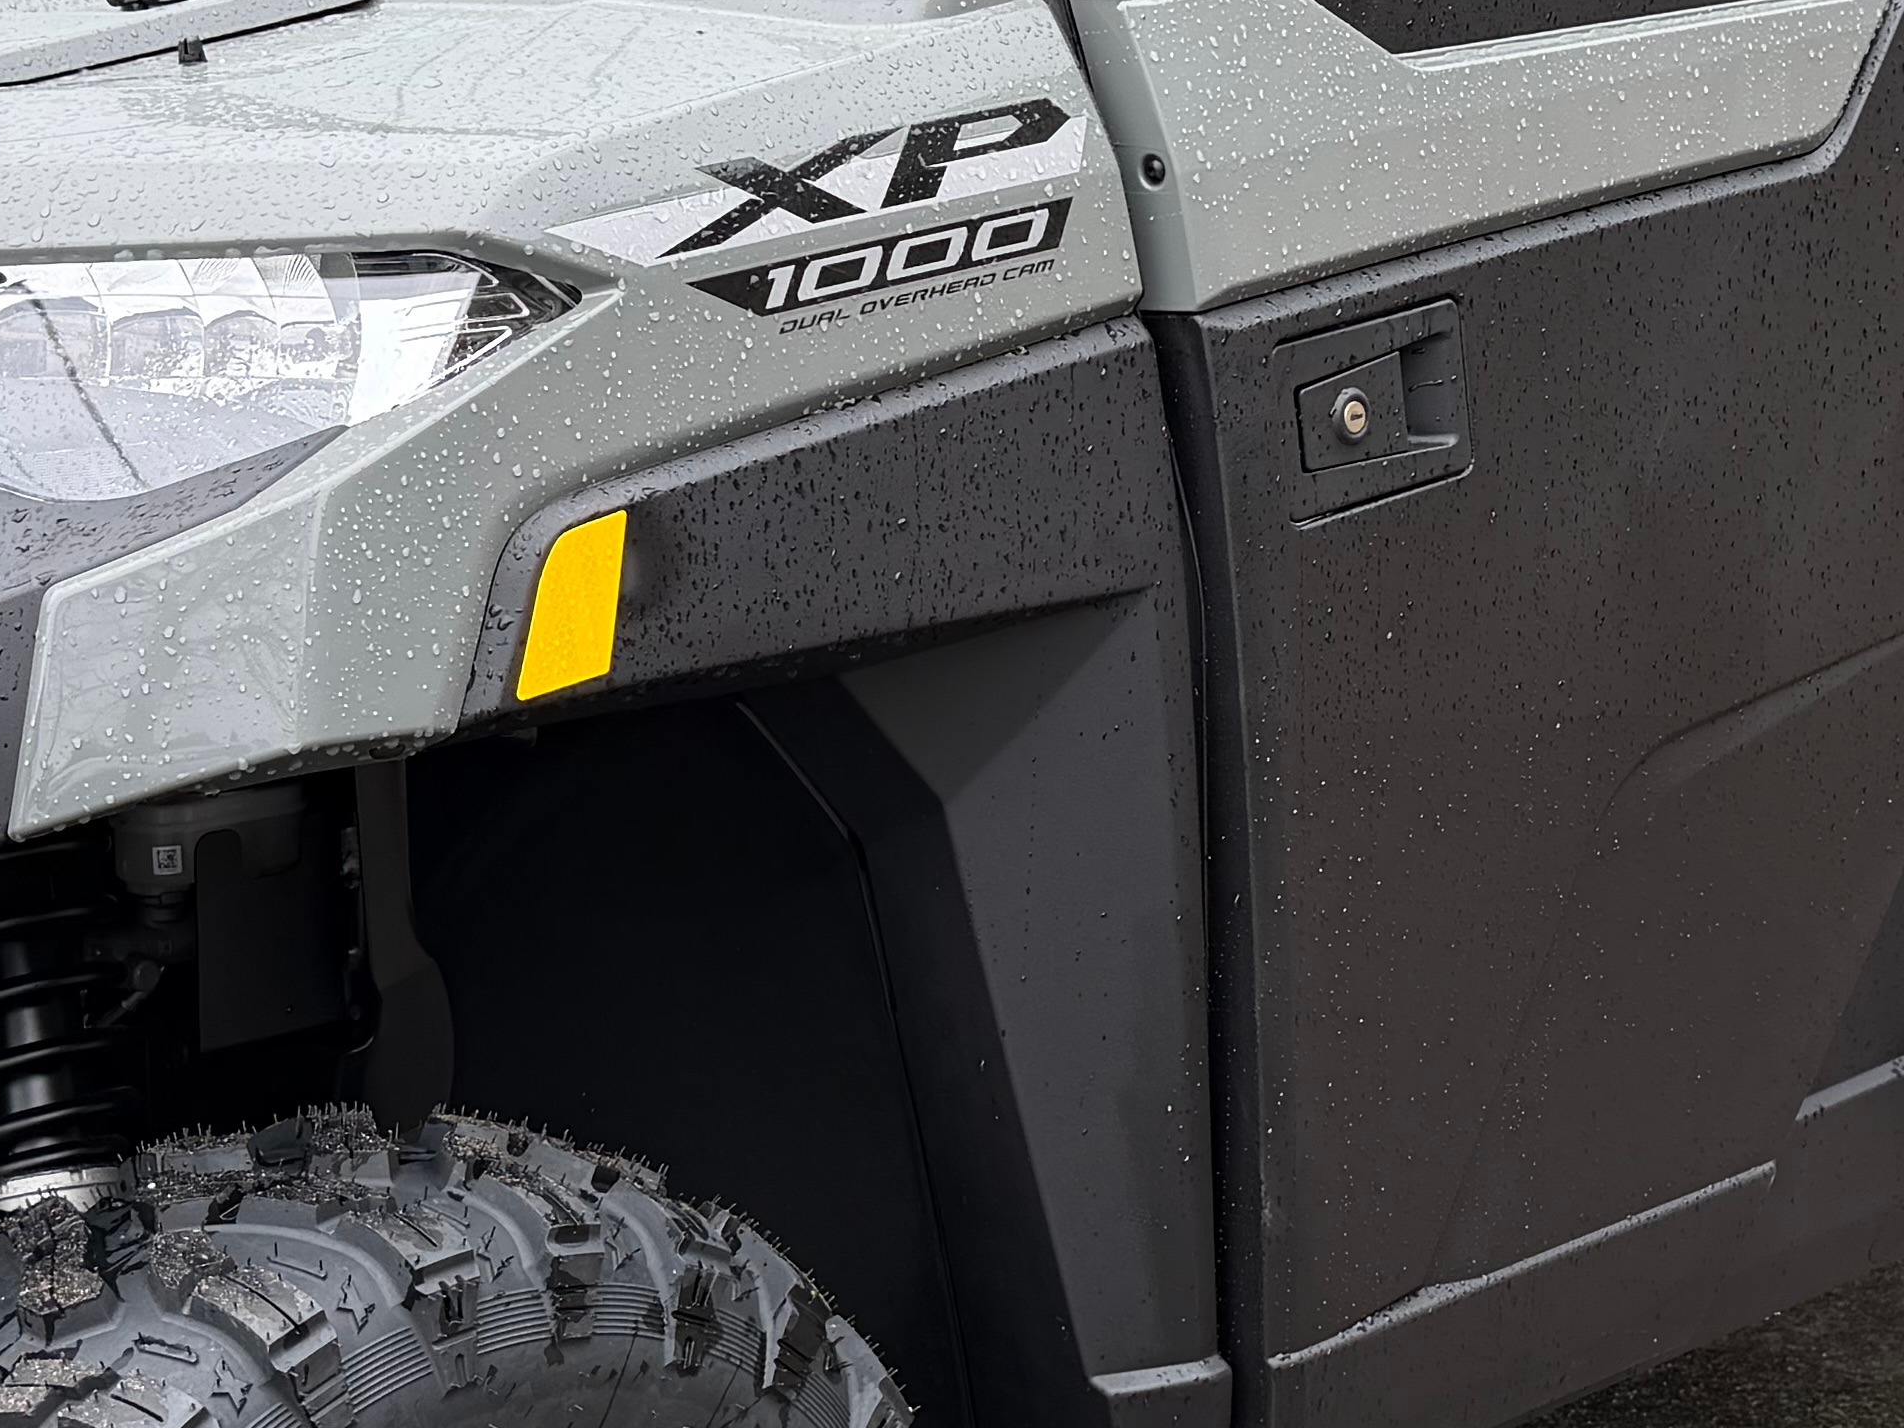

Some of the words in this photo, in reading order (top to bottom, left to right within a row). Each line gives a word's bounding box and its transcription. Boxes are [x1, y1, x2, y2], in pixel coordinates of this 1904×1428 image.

[656, 97, 1074, 259] XP
[765, 206, 1052, 310] 1000
[778, 307, 851, 335] DUAL
[859, 272, 997, 316] OVERHEAD
[1002, 258, 1056, 283] CAM
